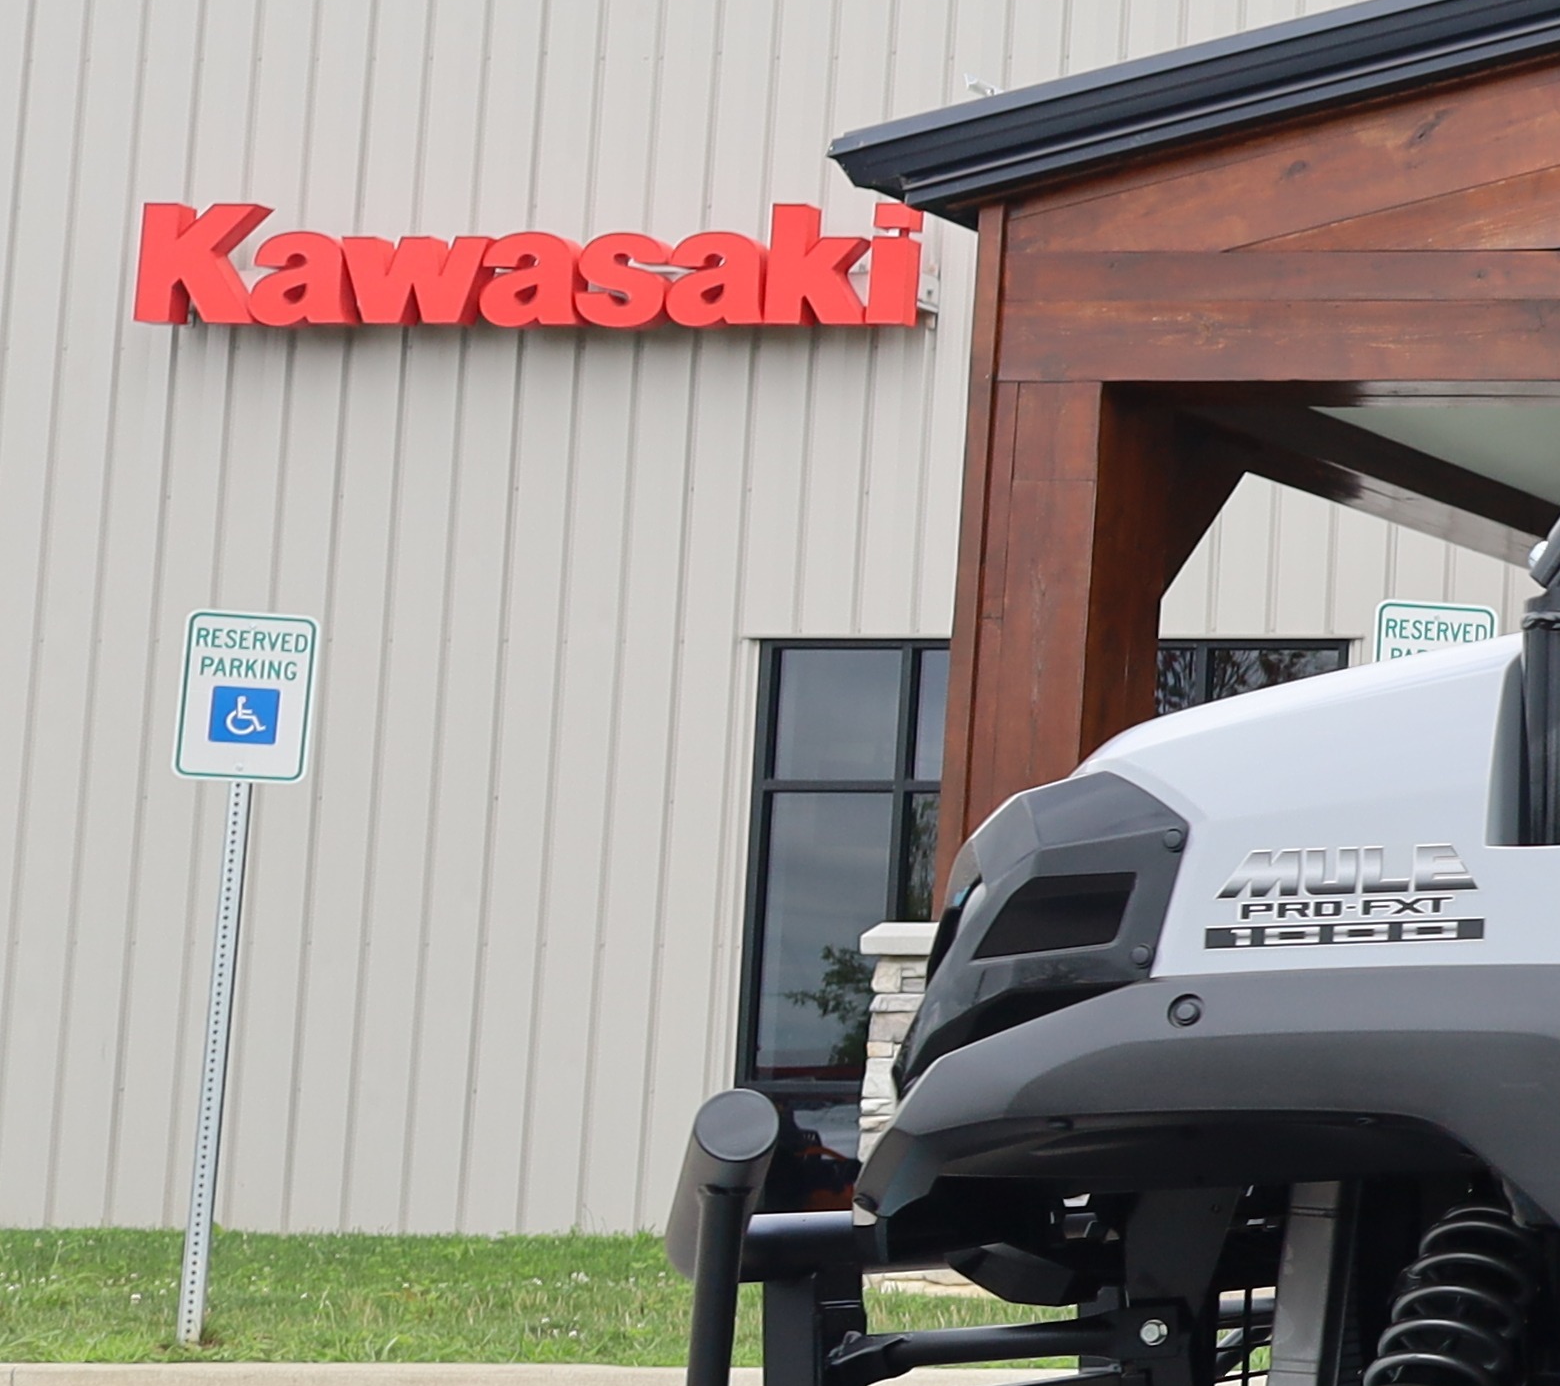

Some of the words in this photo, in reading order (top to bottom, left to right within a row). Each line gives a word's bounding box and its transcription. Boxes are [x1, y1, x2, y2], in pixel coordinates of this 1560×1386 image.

[133, 201, 923, 327] Kawasaki
[195, 626, 309, 655] RESERVED
[1385, 618, 1488, 643] RESERVED
[199, 655, 299, 682] PARKING
[1215, 843, 1477, 899] MULE
[1238, 895, 1454, 920] PRO-FXT
[1227, 922, 1460, 948] 1000
